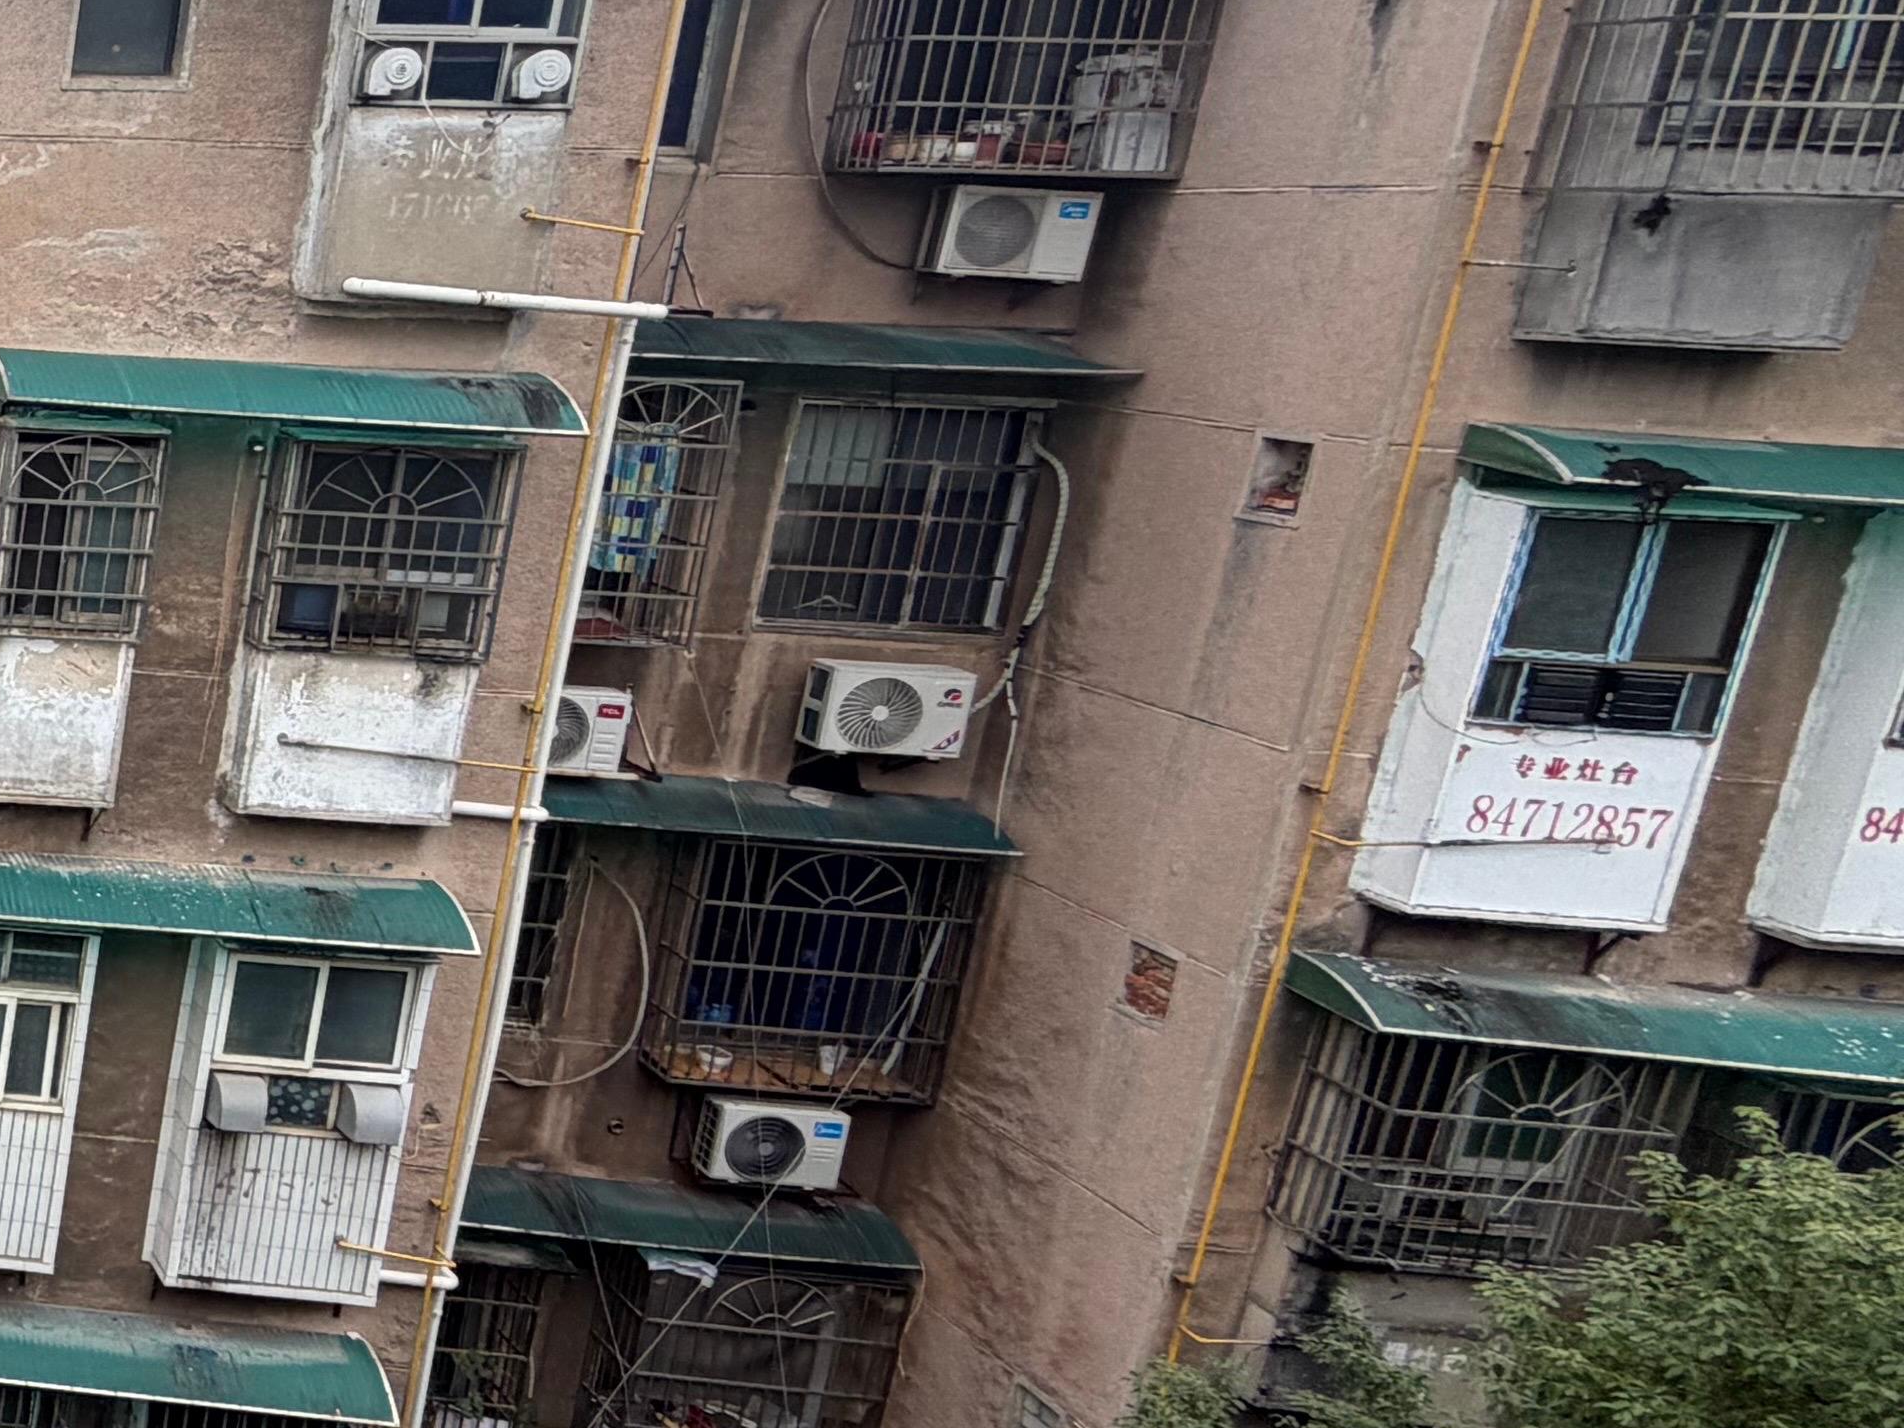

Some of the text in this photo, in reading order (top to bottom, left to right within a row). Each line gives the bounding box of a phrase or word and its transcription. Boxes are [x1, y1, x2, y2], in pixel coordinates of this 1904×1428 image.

[1515, 755, 1640, 787] 专业灶台
[1465, 794, 1675, 851] 84712857
